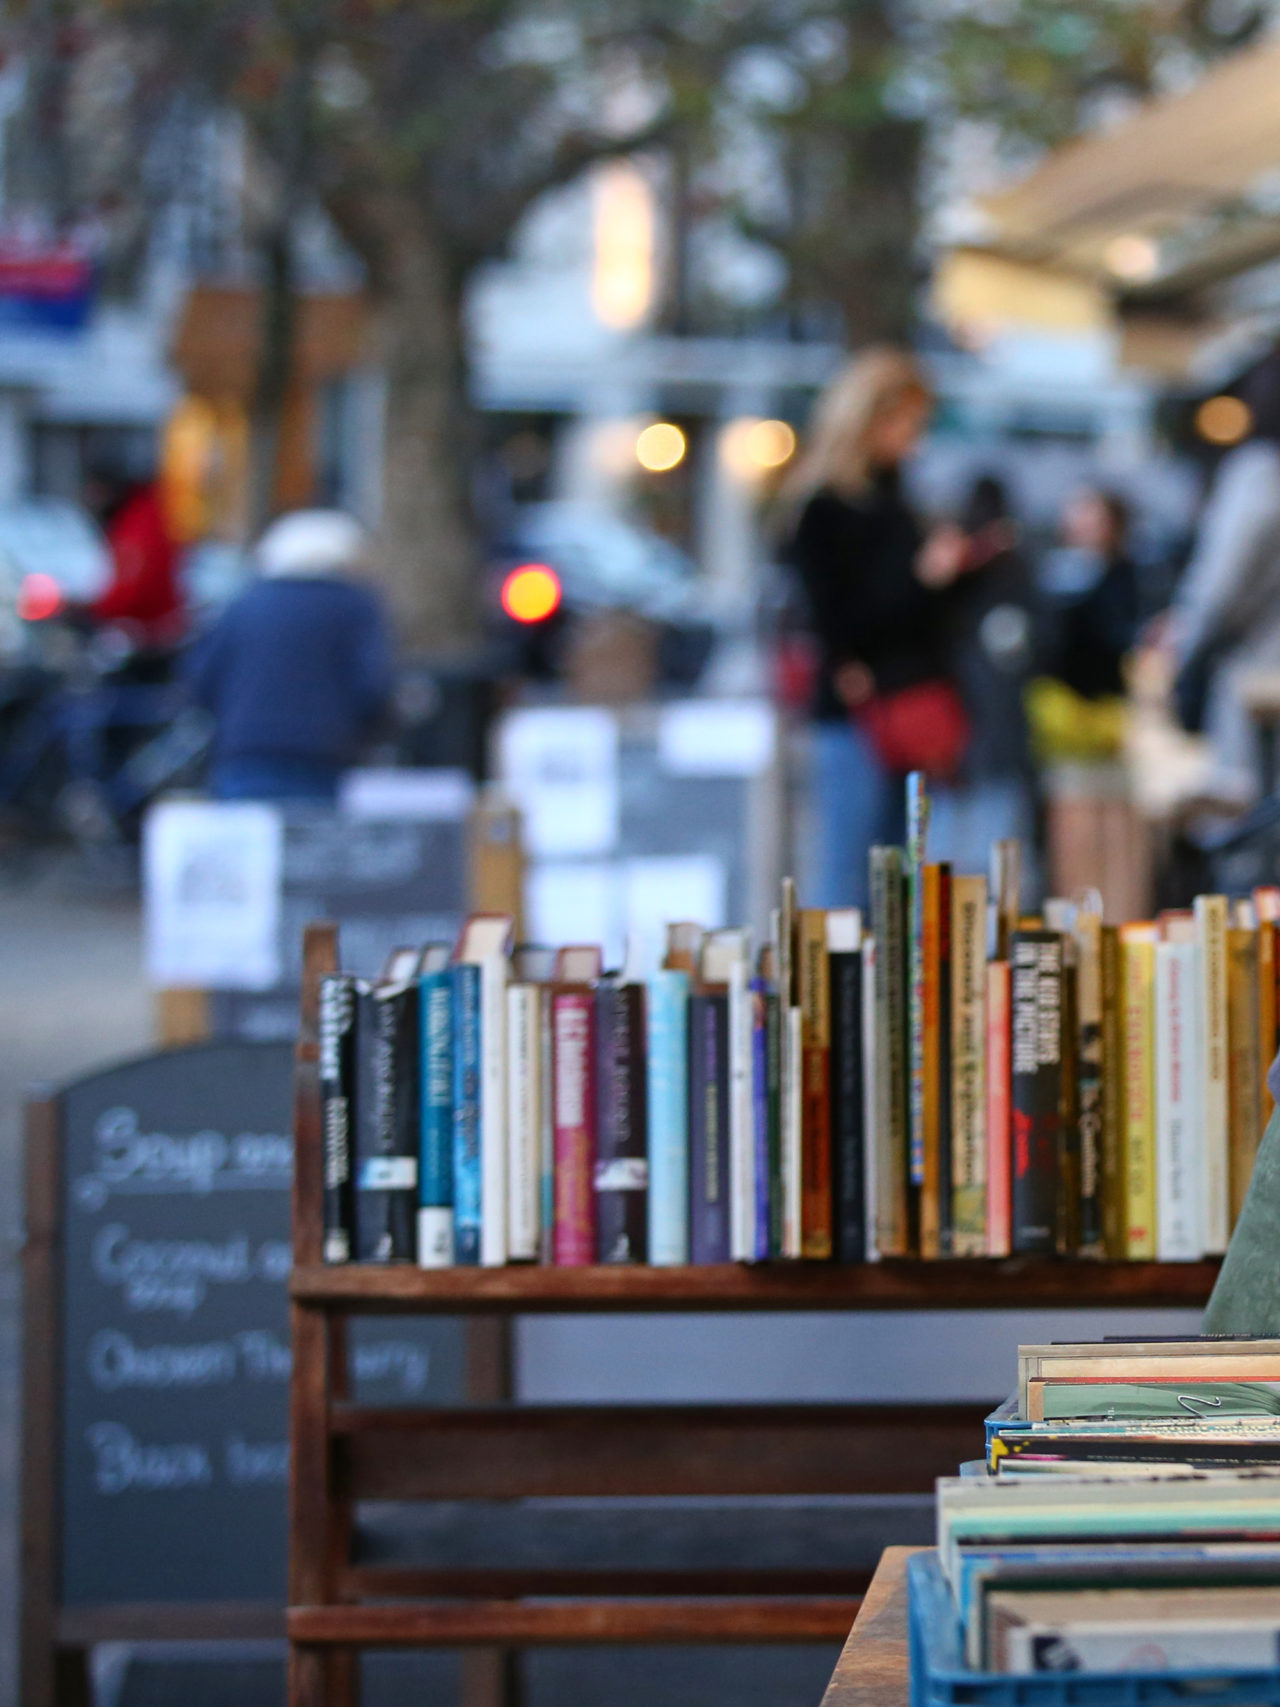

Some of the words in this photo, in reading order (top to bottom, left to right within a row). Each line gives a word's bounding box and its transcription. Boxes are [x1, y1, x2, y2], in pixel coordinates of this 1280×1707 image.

[1014, 942, 1037, 962] IN
[1039, 942, 1061, 971] THE
[1014, 968, 1037, 998] THE
[1039, 977, 1060, 1006] KID
[1014, 1003, 1037, 1075] PICTURE
[1038, 1011, 1061, 1064] STAYS
[95, 1106, 228, 1193] Soup
